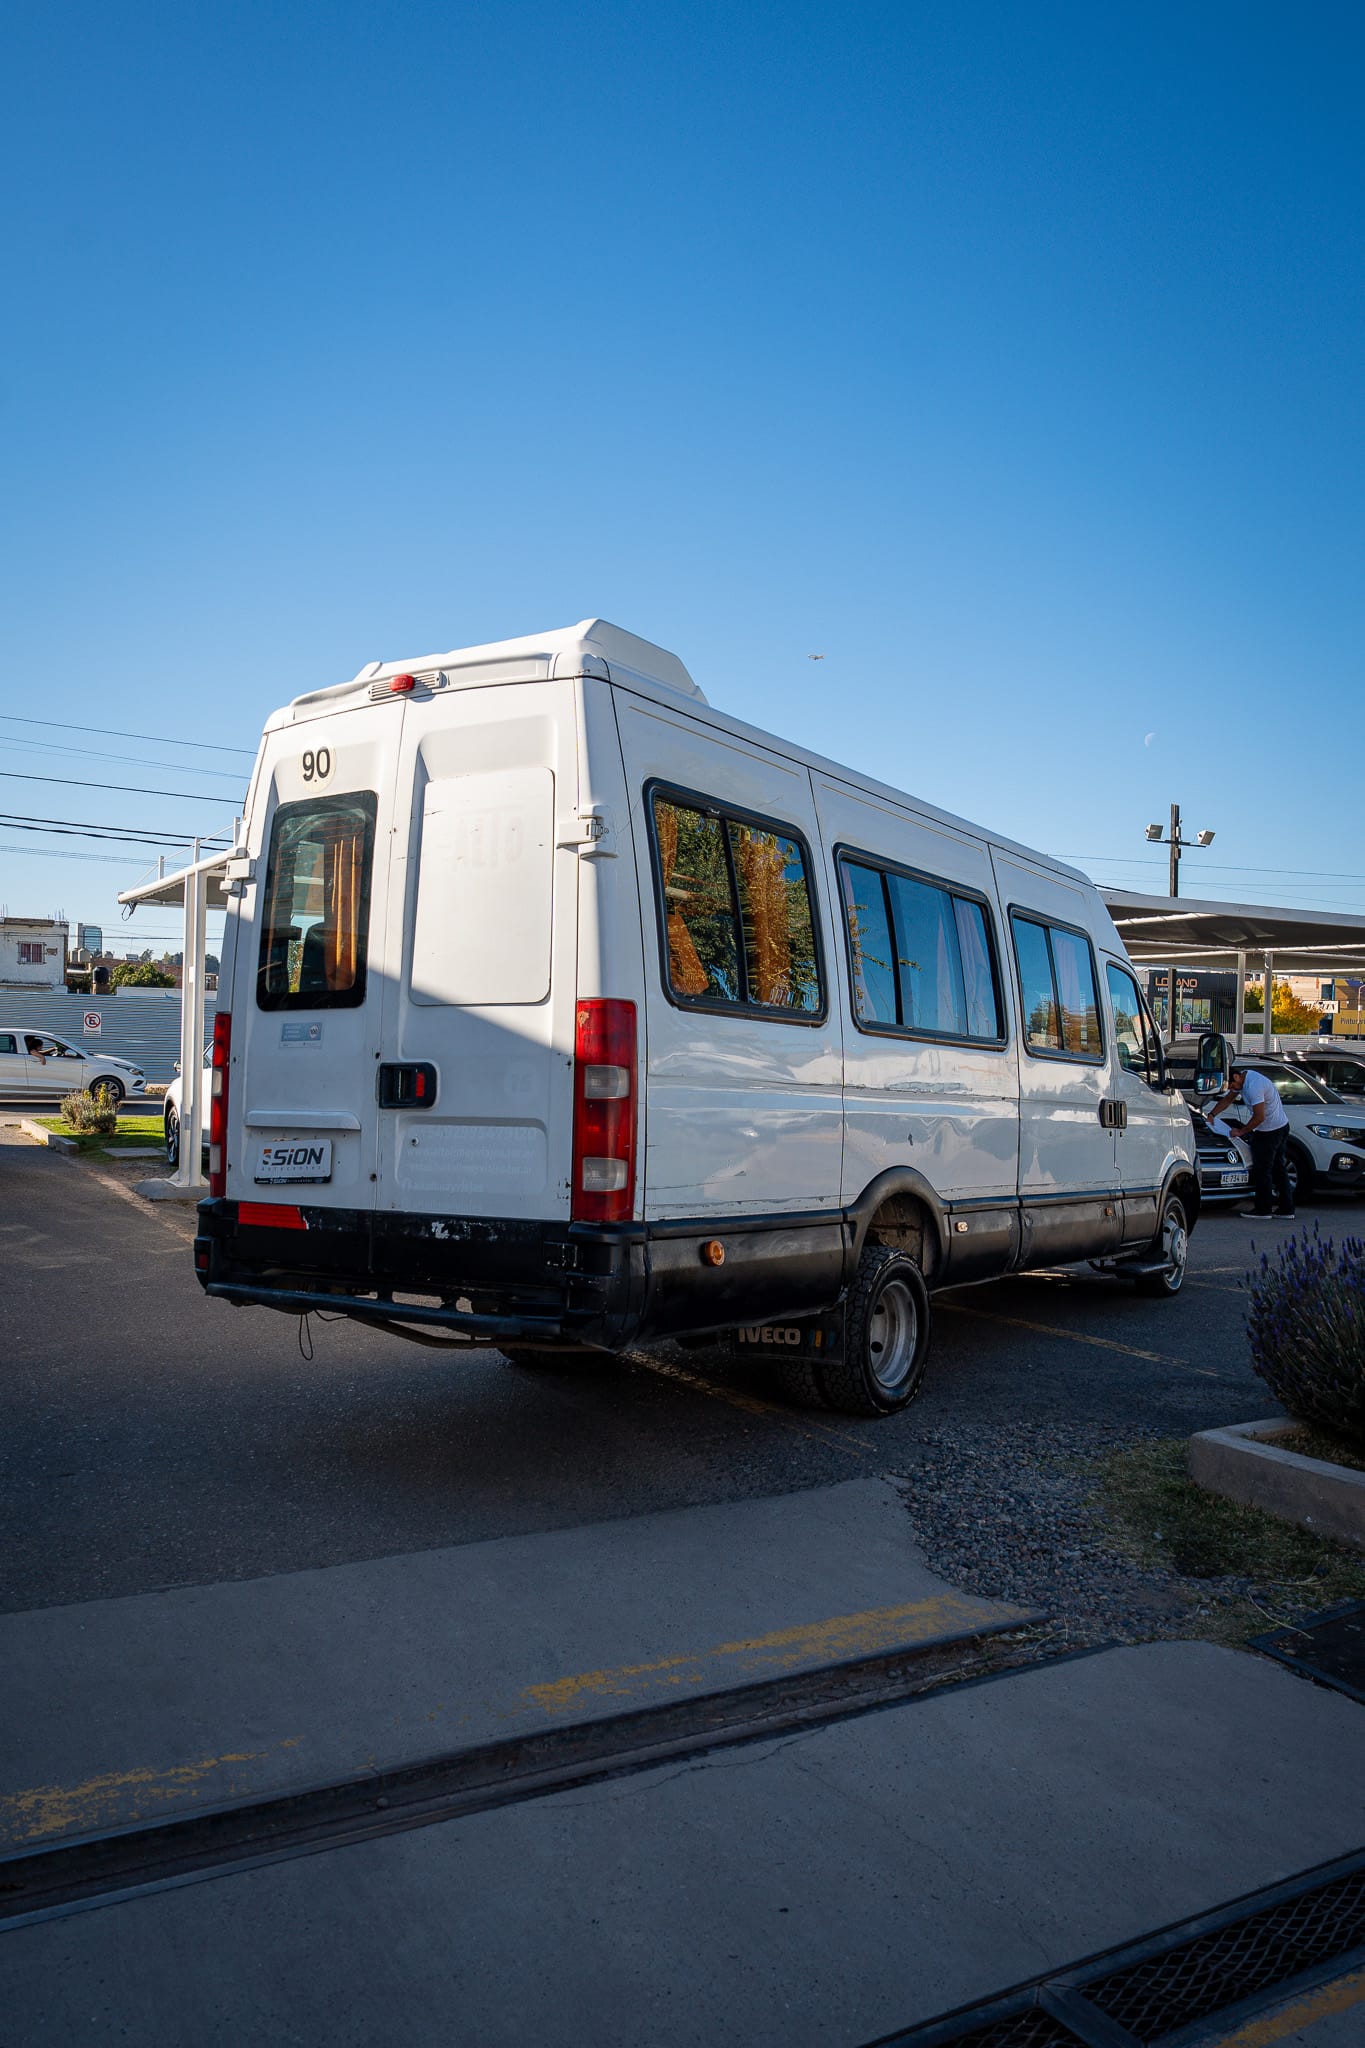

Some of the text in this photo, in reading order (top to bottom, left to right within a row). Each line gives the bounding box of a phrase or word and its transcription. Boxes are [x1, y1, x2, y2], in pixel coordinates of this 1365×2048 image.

[302, 746, 331, 781] 90
[1155, 976, 1198, 988] LOANO
[738, 1326, 801, 1345] IVECO
